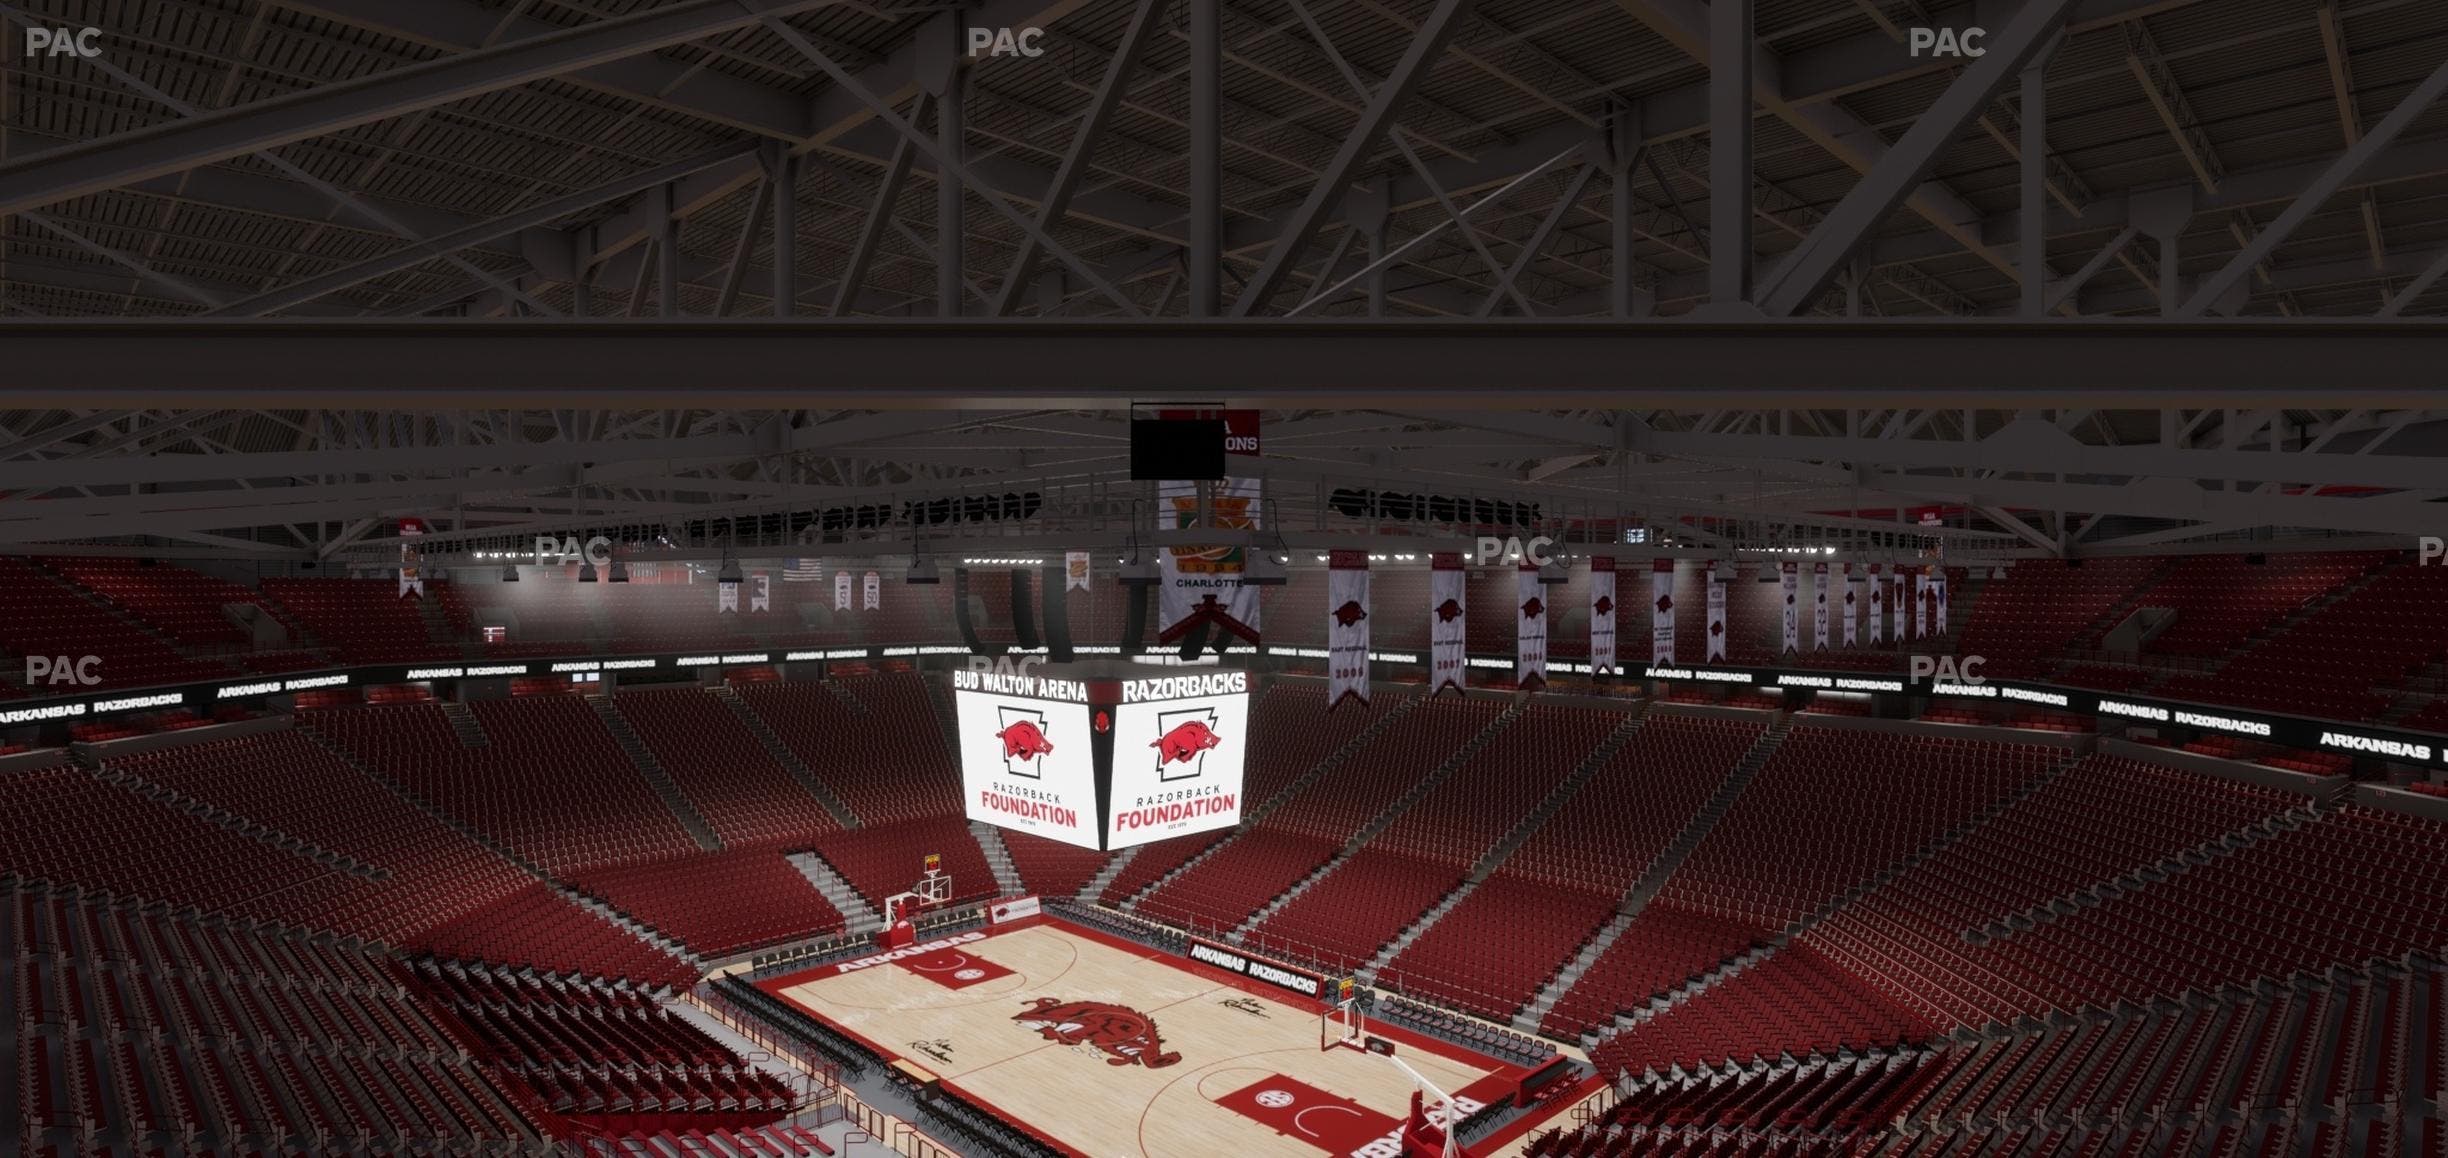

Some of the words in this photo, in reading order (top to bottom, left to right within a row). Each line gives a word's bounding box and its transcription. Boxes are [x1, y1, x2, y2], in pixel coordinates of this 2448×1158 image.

[1176, 578, 1244, 588] CHARLOTTE
[407, 668, 462, 679] ARKANSAS
[467, 665, 527, 676] RAZORBACKS
[552, 661, 600, 672] ARKANSAS
[1696, 670, 1752, 683] RAZORBACKS
[217, 682, 281, 699] ARKANSAS
[286, 675, 348, 690] RAZORBACKS
[954, 669, 978, 689] BUD
[982, 672, 1034, 697] WALTON
[1038, 678, 1089, 703] ARENA
[1121, 671, 1247, 704] RAZORBACKS
[1778, 675, 1832, 688] ARKANSAS
[1836, 679, 1903, 691] RAZORBACKS
[1933, 684, 1997, 697] ARKANSAS
[2002, 688, 2068, 706] RAZORBACKS
[94, 694, 183, 713] RAZORBACKS
[2098, 701, 2169, 720] ARKANSAS
[2175, 712, 2271, 736] RAZORBACKS
[2320, 732, 2431, 760] ARKANSAS
[992, 782, 1061, 804] RAZORBACK
[1136, 784, 1221, 808] RAZORBACK
[981, 791, 1077, 829] FOUNDATION
[1116, 794, 1235, 832] FOUNDATION
[836, 931, 987, 973] ARKANSAS
[1190, 943, 1245, 973] ARKANSAS
[1249, 963, 1317, 995] RAZORBACKS
